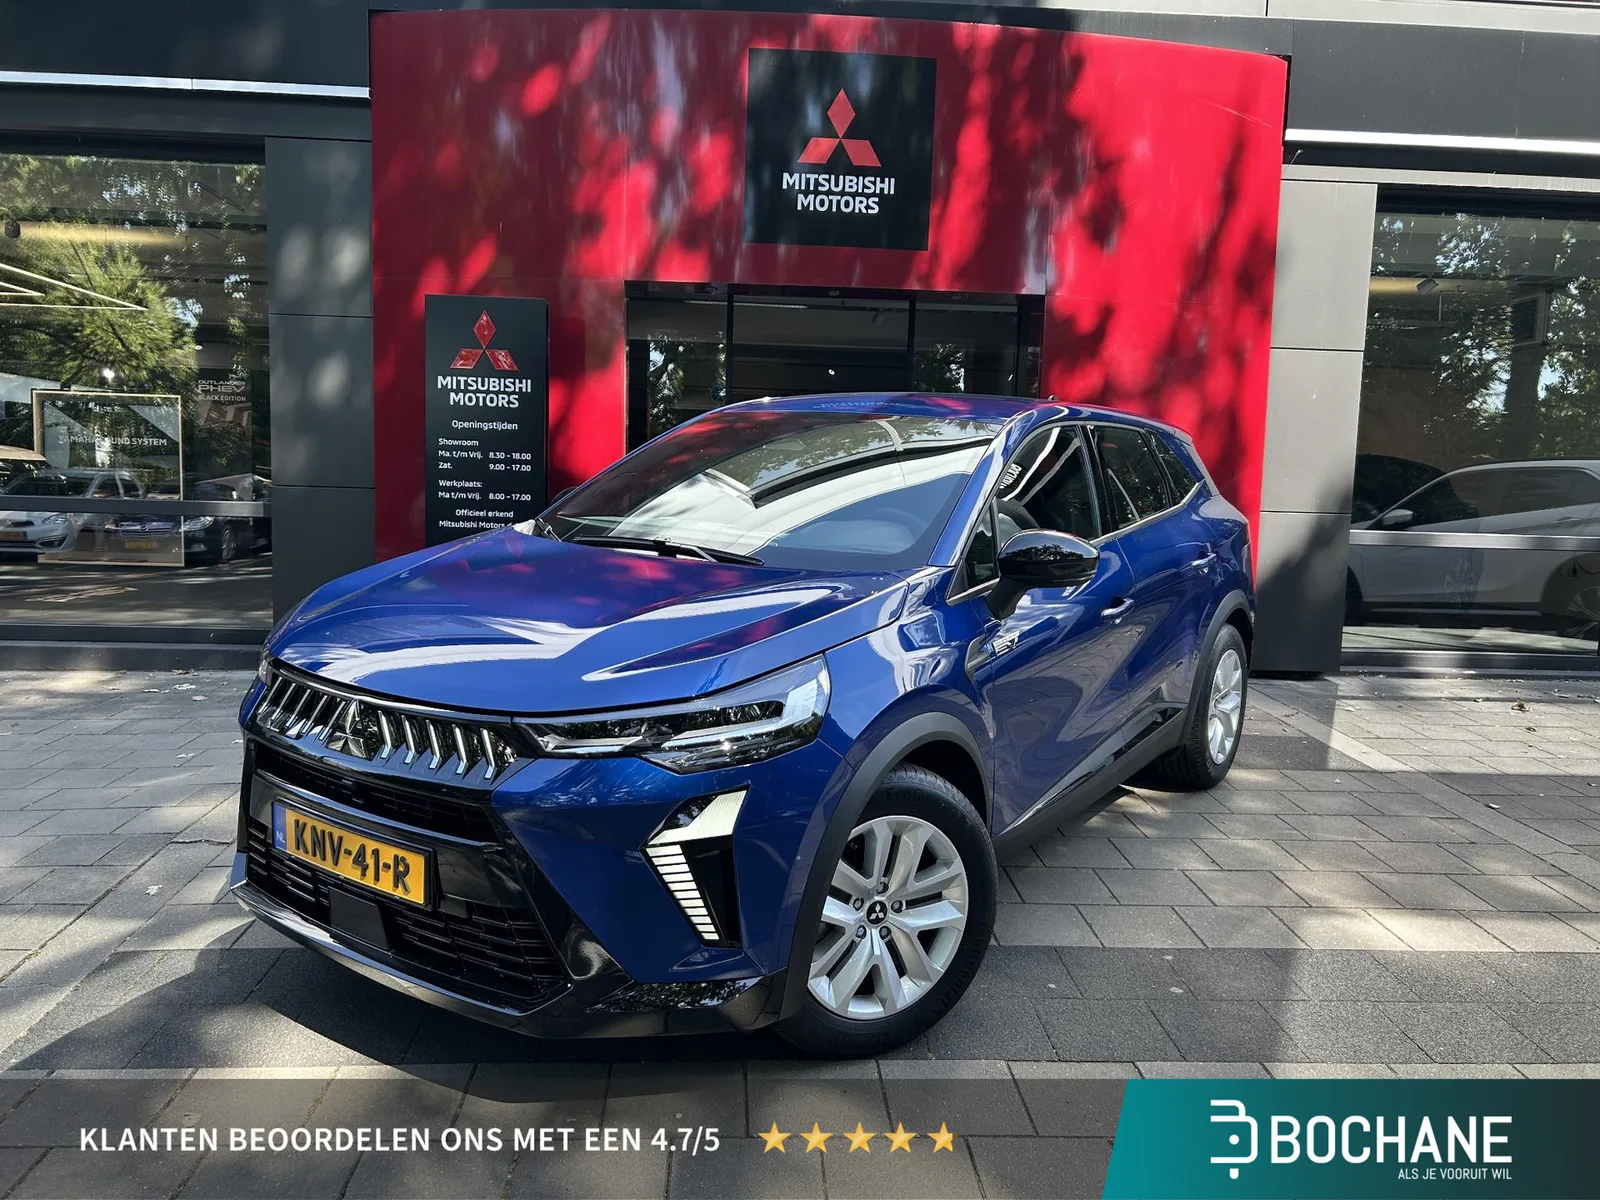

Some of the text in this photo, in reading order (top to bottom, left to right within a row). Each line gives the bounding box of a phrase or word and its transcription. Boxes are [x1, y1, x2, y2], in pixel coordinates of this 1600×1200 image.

[782, 172, 895, 195] MITSUBISHI
[796, 193, 880, 214] MOTORS
[198, 384, 246, 393] PHEV
[437, 375, 532, 392] MITSUBISHI
[449, 392, 519, 408] MOTORS
[451, 420, 518, 431] Openingstijden
[131, 437, 167, 446] SYSTEM
[438, 438, 479, 446] Showroom
[438, 450, 451, 458] Ma.
[452, 450, 468, 458] t/m
[469, 450, 483, 459] Vrij.
[489, 451, 505, 459] 8.30
[512, 452, 532, 460] 18.00
[489, 463, 505, 471] 9.00
[512, 464, 532, 472] 17.00
[438, 479, 483, 488] Werkplaats:
[438, 491, 450, 499] Ma
[451, 491, 466, 499] t/m
[467, 492, 482, 500] Vrij.
[512, 493, 532, 501] 17.00
[455, 508, 514, 518] Officieel erkend
[439, 520, 478, 528] Mitsubishi
[276, 830, 286, 843] NL
[293, 818, 411, 895] KNV-41-R
